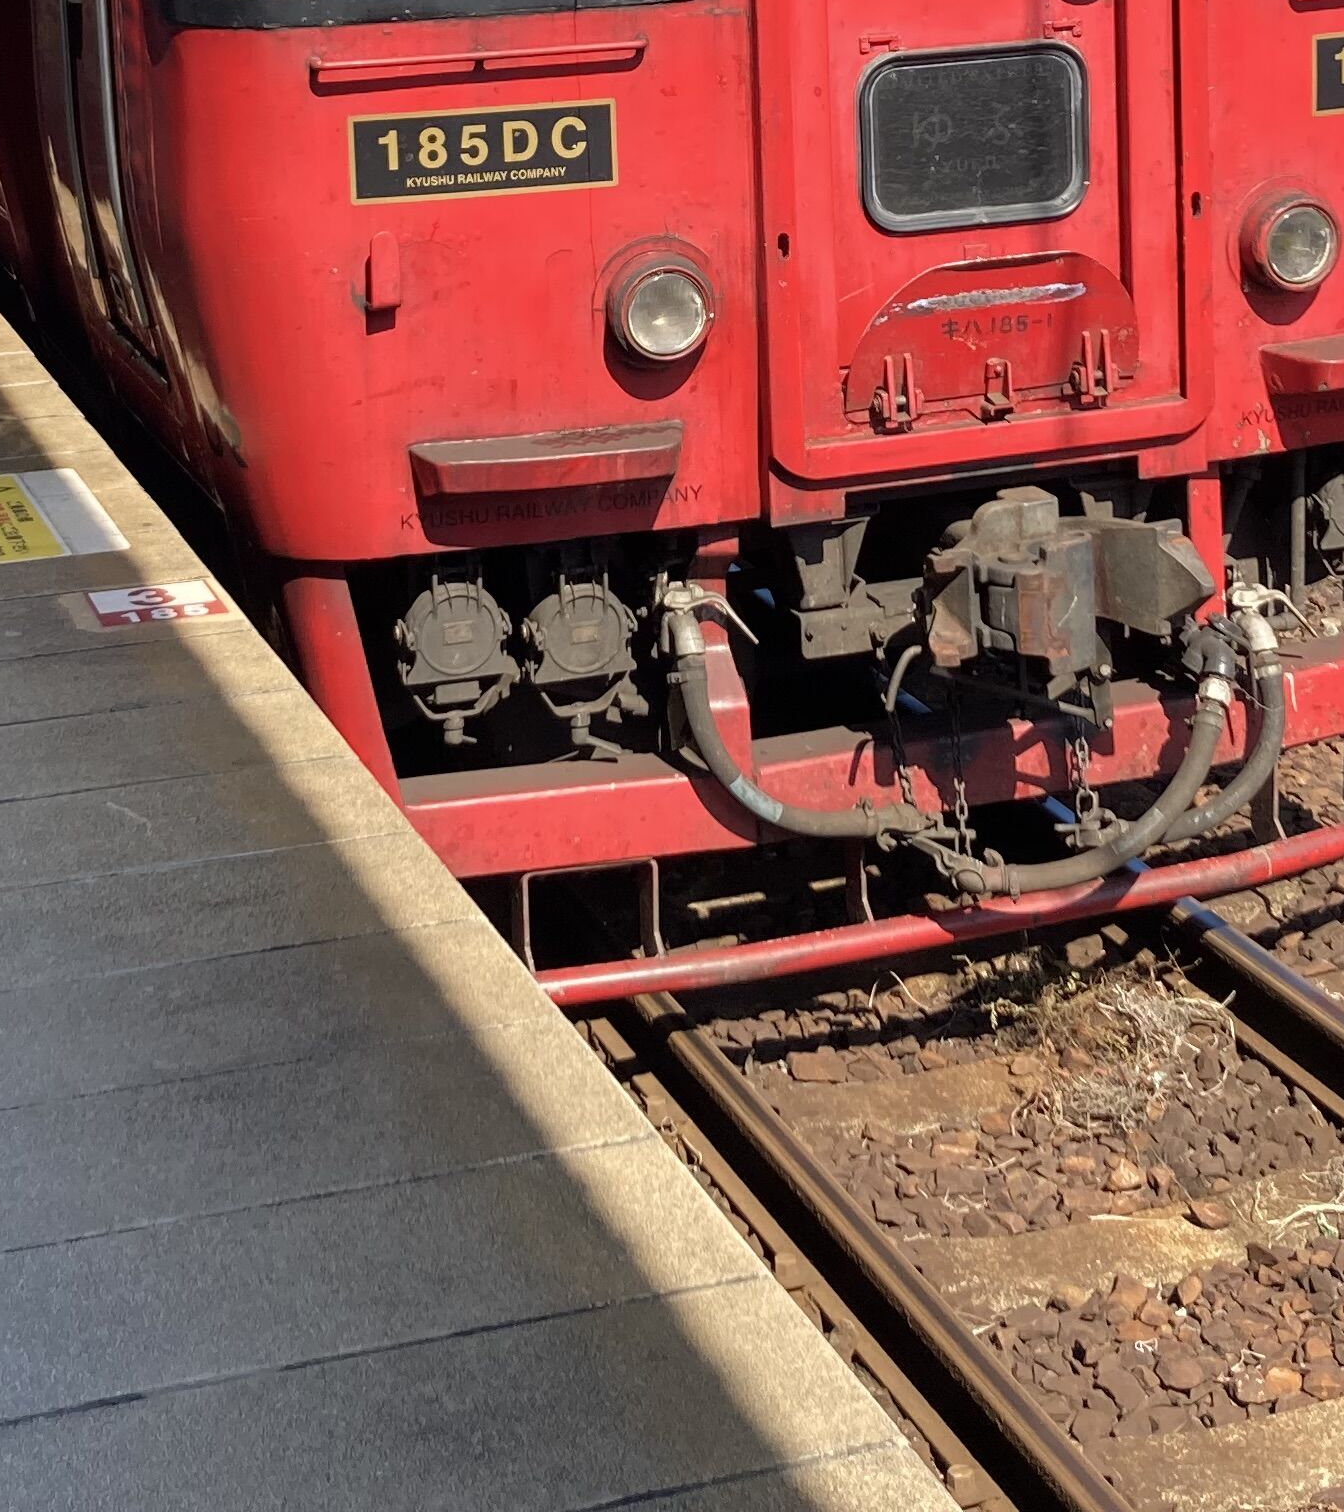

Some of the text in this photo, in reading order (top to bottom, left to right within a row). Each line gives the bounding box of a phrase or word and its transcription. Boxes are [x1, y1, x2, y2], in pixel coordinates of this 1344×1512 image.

[377, 116, 588, 171] 185DC
[406, 166, 567, 189] KYUSHU RAILWAY COMPANY
[1241, 403, 1311, 426] KYUSHU
[400, 485, 704, 531] KYUSHU RAILWAY COMPANY
[127, 587, 177, 606] 3
[119, 603, 210, 623] 185
